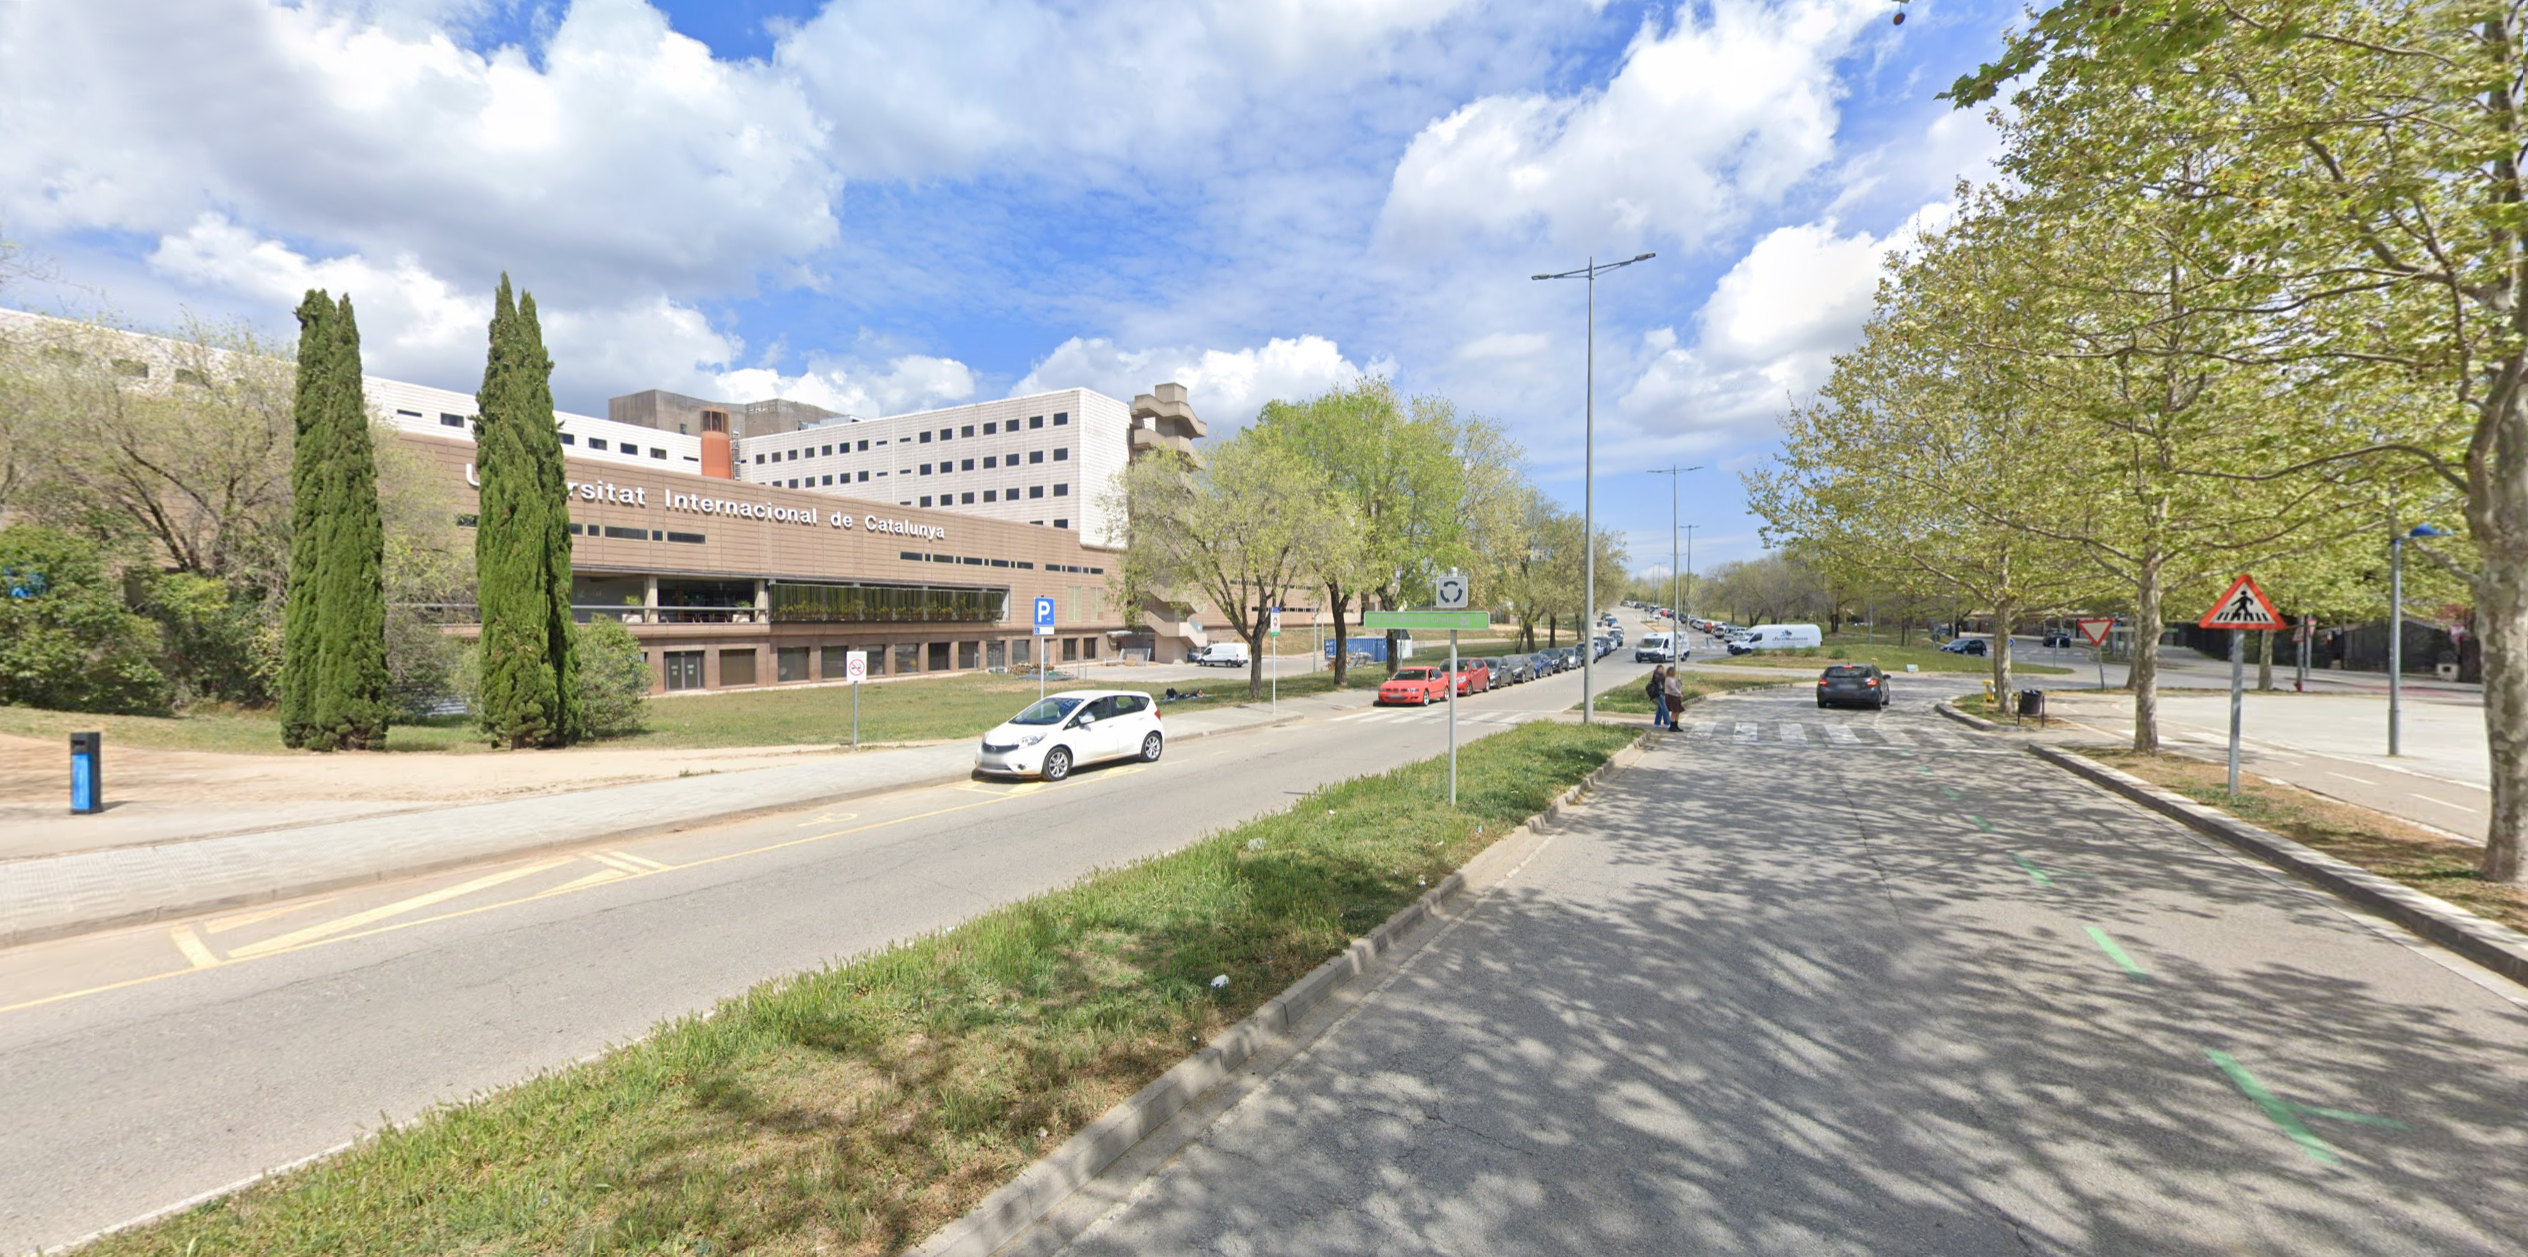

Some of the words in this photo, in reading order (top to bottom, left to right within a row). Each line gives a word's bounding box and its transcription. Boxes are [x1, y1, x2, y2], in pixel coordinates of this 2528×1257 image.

[465, 463, 646, 505] Ursitat
[665, 489, 817, 524] Internacional
[830, 511, 853, 528] de
[864, 515, 945, 540] Catalunya
[1038, 601, 1051, 623] P
